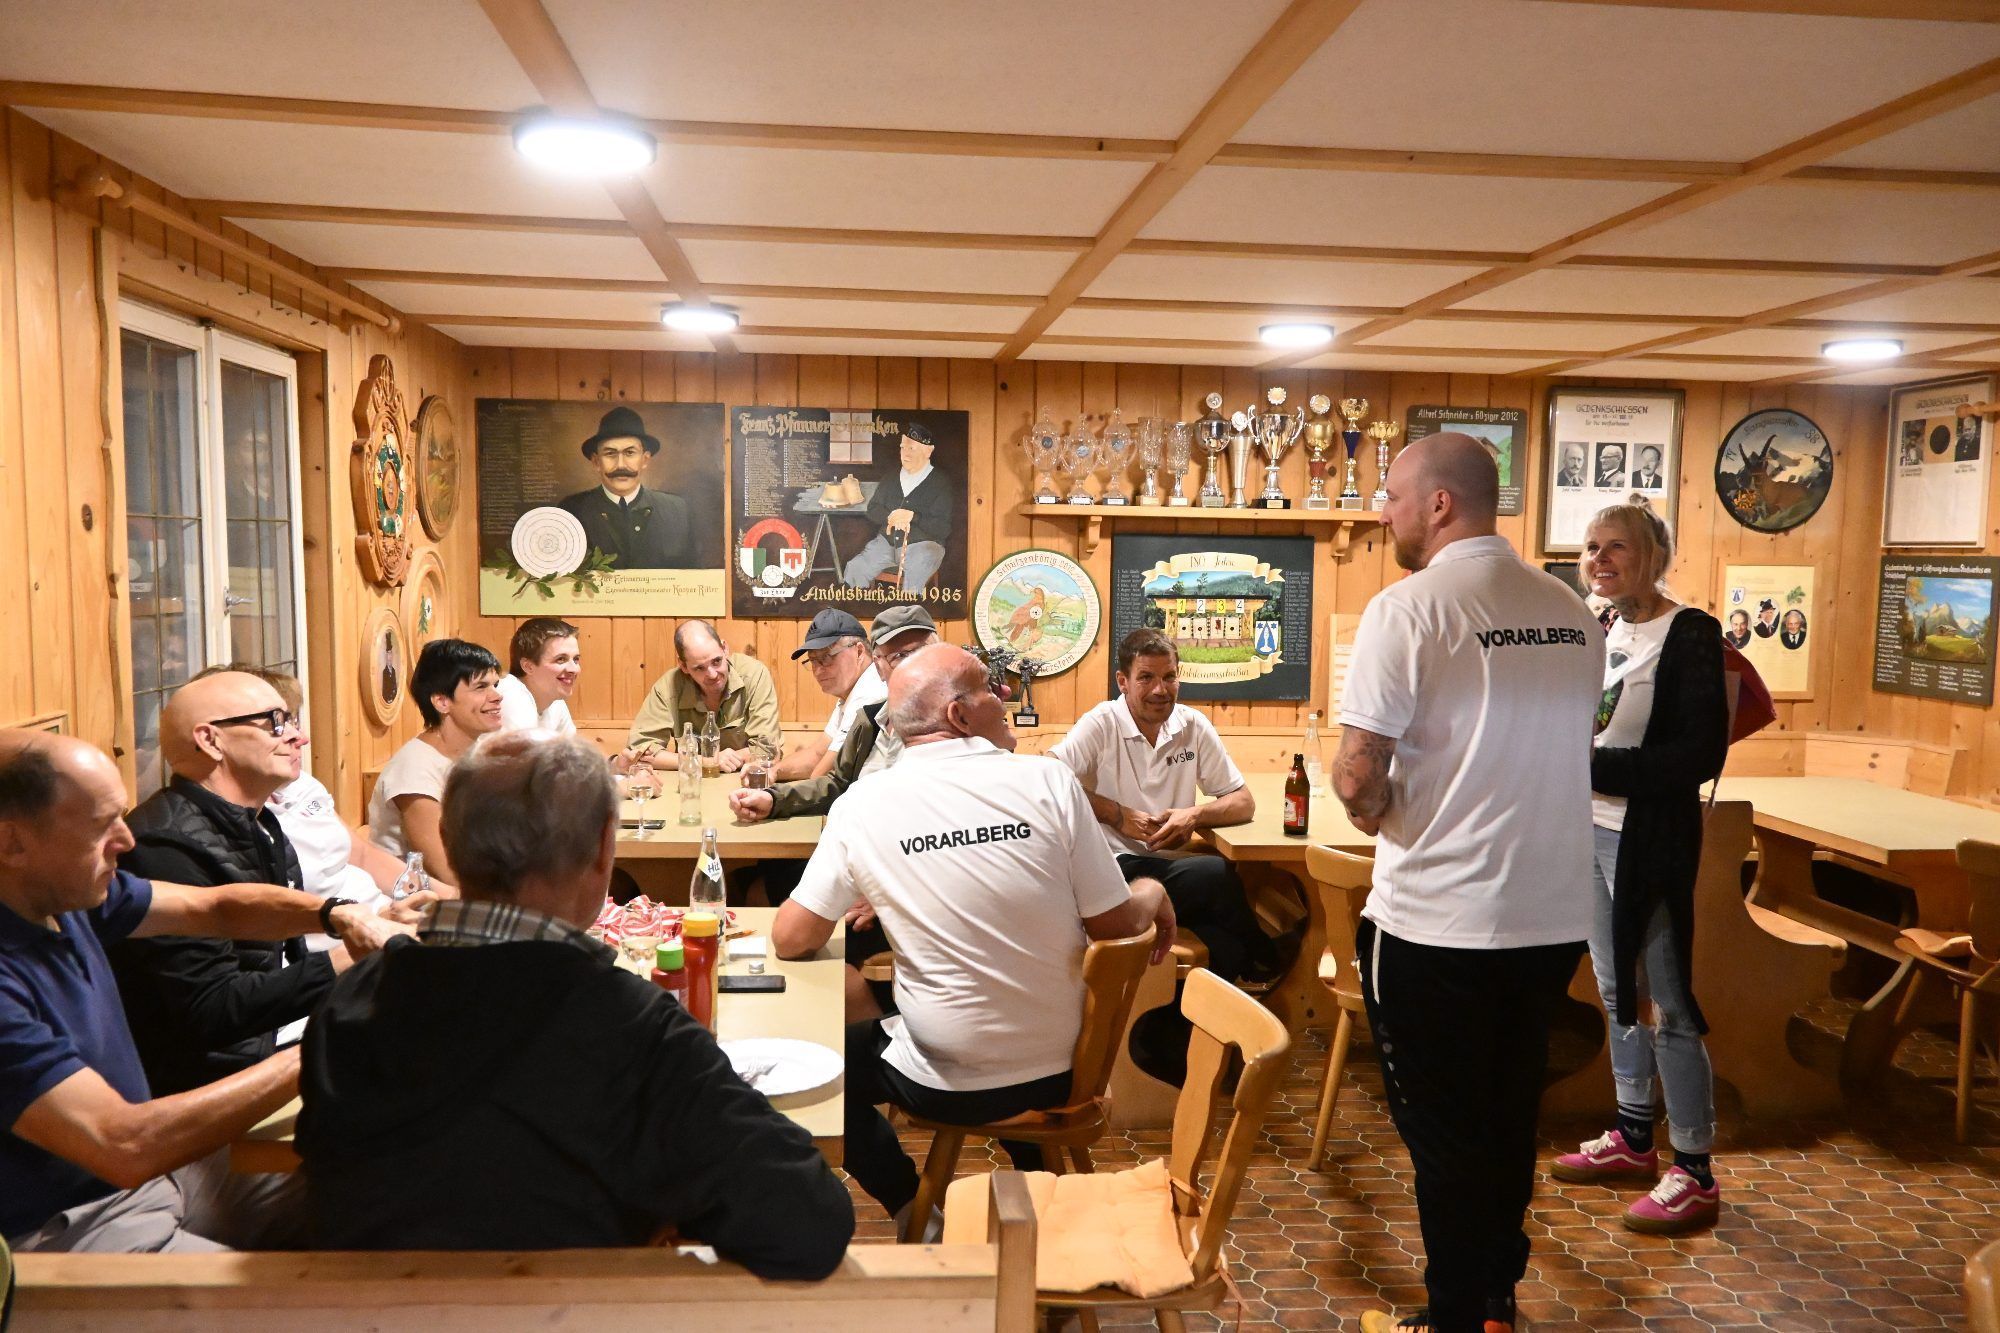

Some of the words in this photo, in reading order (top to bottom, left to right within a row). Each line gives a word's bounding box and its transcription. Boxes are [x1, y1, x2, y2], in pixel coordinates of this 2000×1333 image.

[739, 411, 776, 436] Franz
[776, 410, 830, 438] Pfanner
[1500, 411, 1519, 421] 2012
[1475, 627, 1586, 648] VORARLBERG
[900, 822, 1031, 855] VORARLBERG
